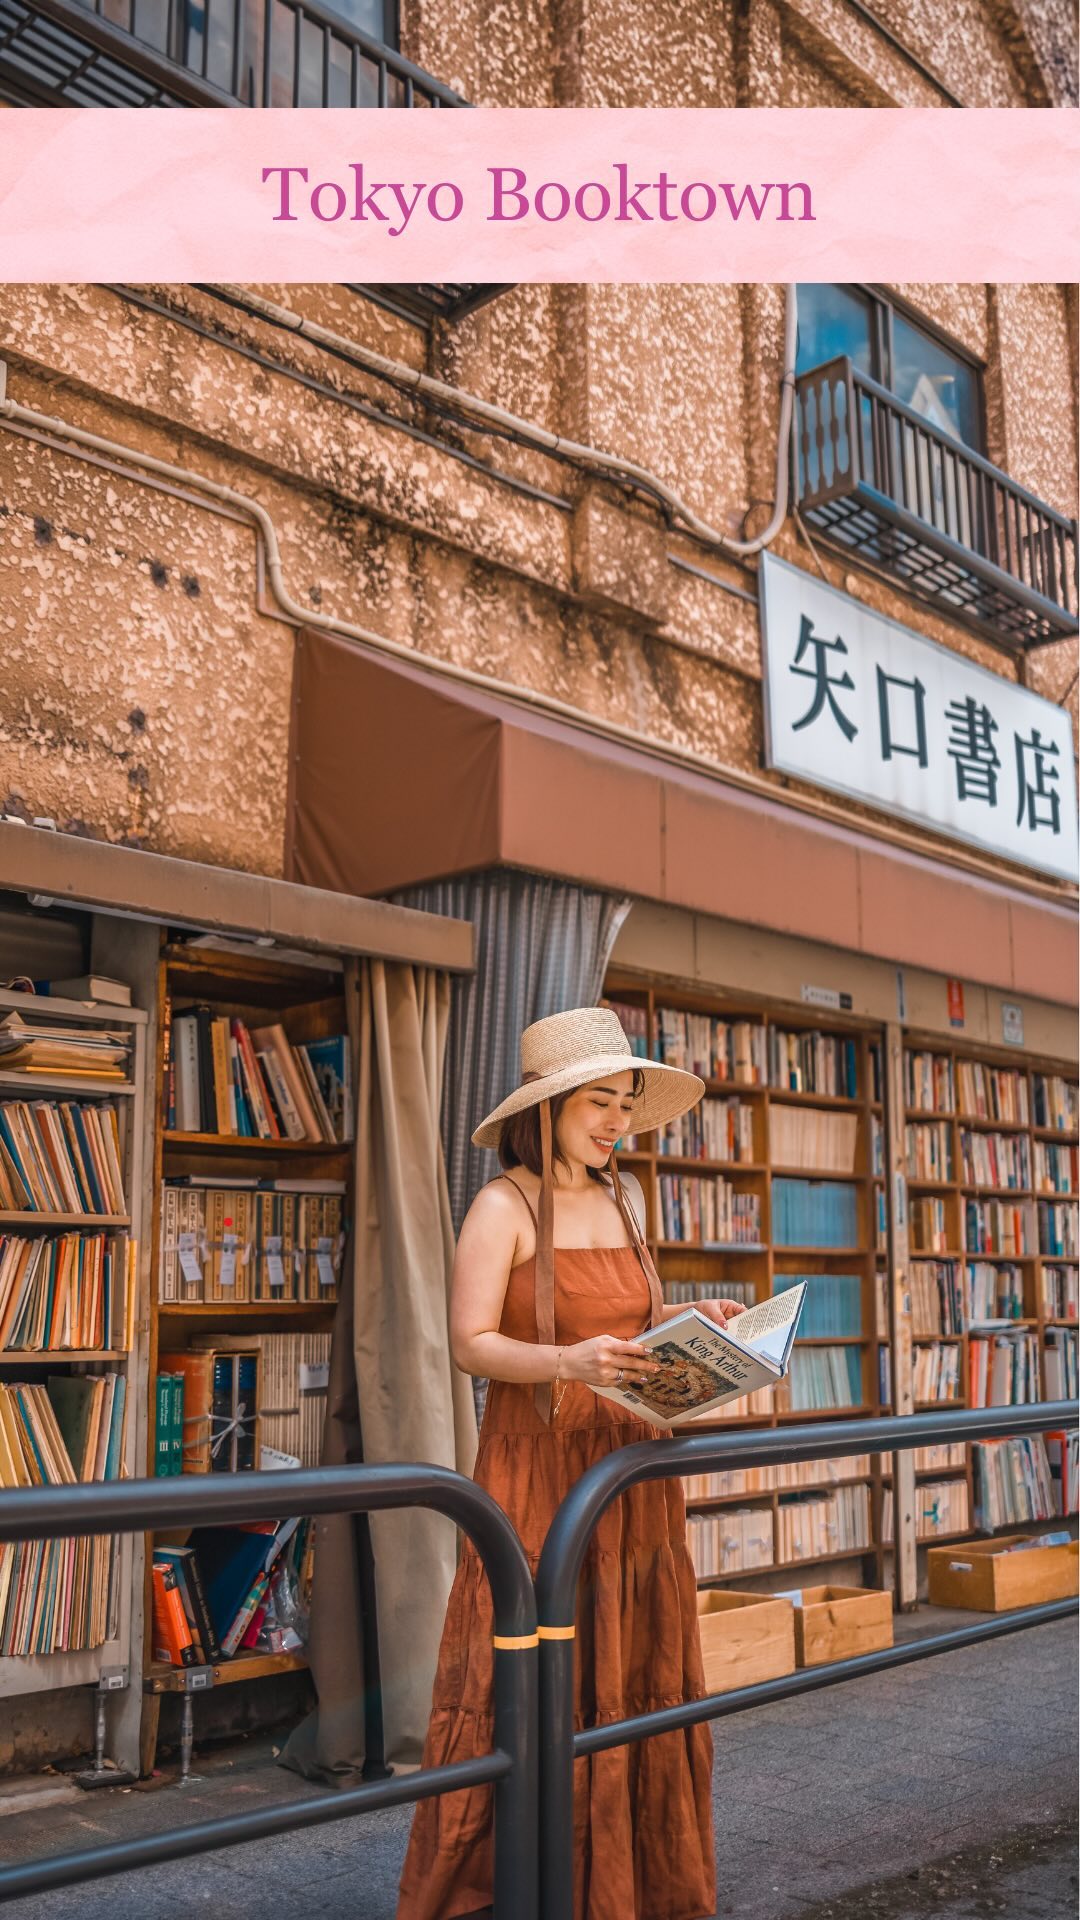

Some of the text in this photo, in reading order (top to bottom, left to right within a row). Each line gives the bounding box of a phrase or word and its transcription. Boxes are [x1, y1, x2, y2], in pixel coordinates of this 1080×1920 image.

[789, 613, 1061, 835] 矢口書店
[685, 1336, 714, 1359] King
[710, 1356, 748, 1380] Arthur
[707, 1338, 721, 1349] The
[718, 1346, 743, 1364] Mystery
[159, 1440, 168, 1452] III
